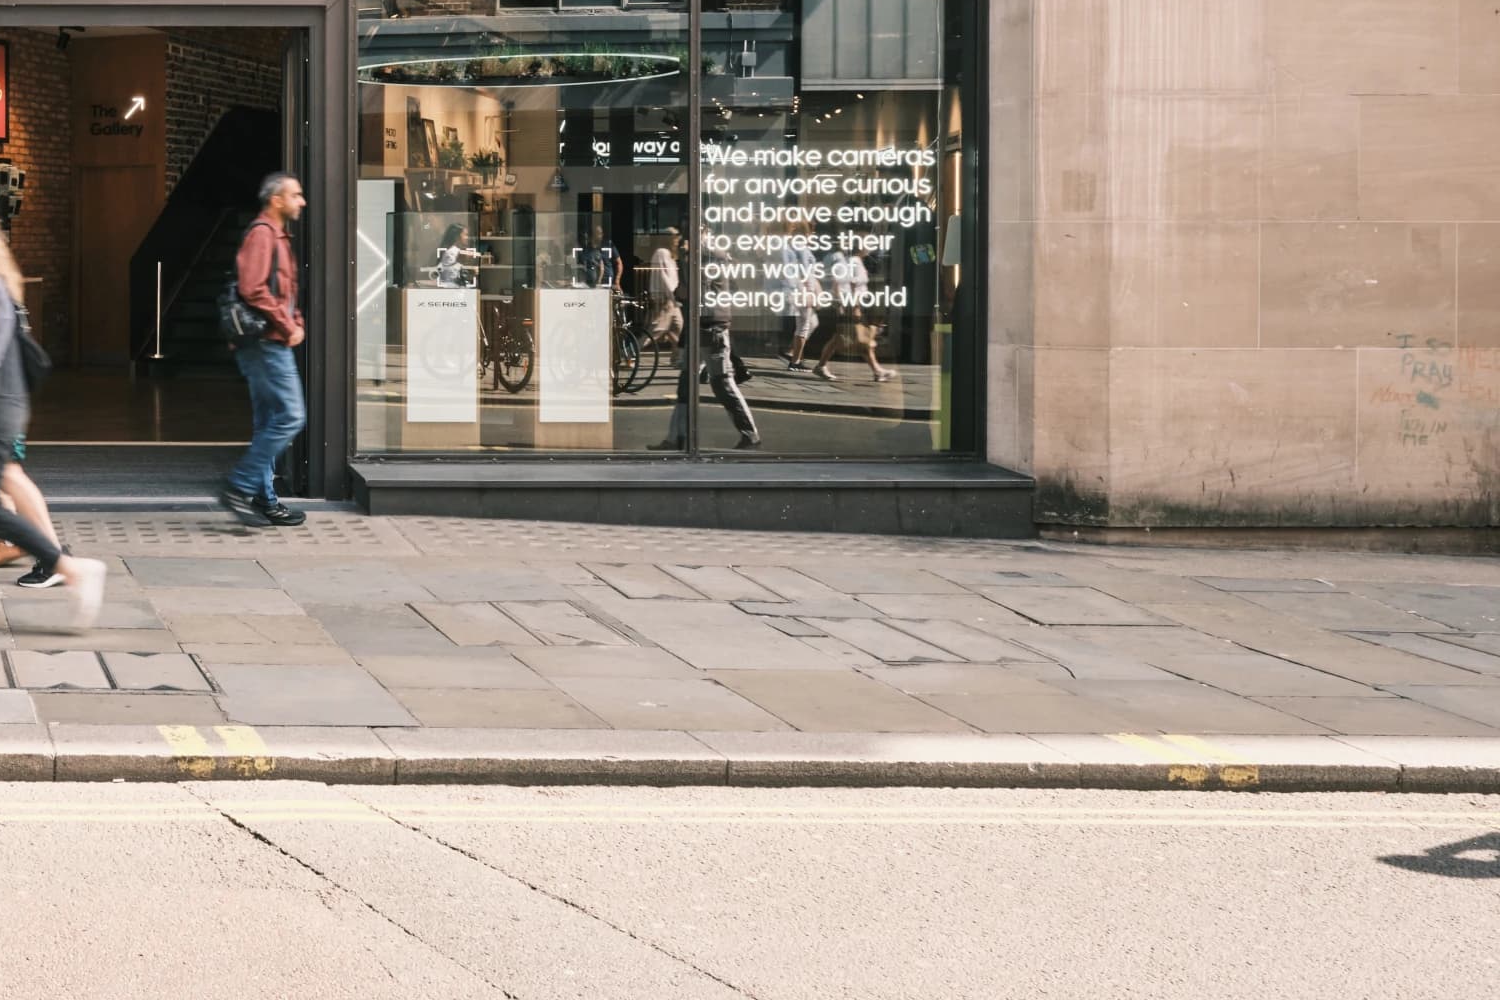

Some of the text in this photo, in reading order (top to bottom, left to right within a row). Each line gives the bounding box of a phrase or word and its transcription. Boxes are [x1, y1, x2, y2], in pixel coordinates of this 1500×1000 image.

[92, 104, 117, 118] The
[90, 122, 144, 138] Gallery
[707, 145, 935, 167] We make cameras
[704, 173, 932, 199] for anyone curious
[704, 202, 932, 228] and brave enough
[705, 230, 895, 255] to express their
[704, 260, 858, 282] own ways of
[704, 286, 908, 312] seeing the world
